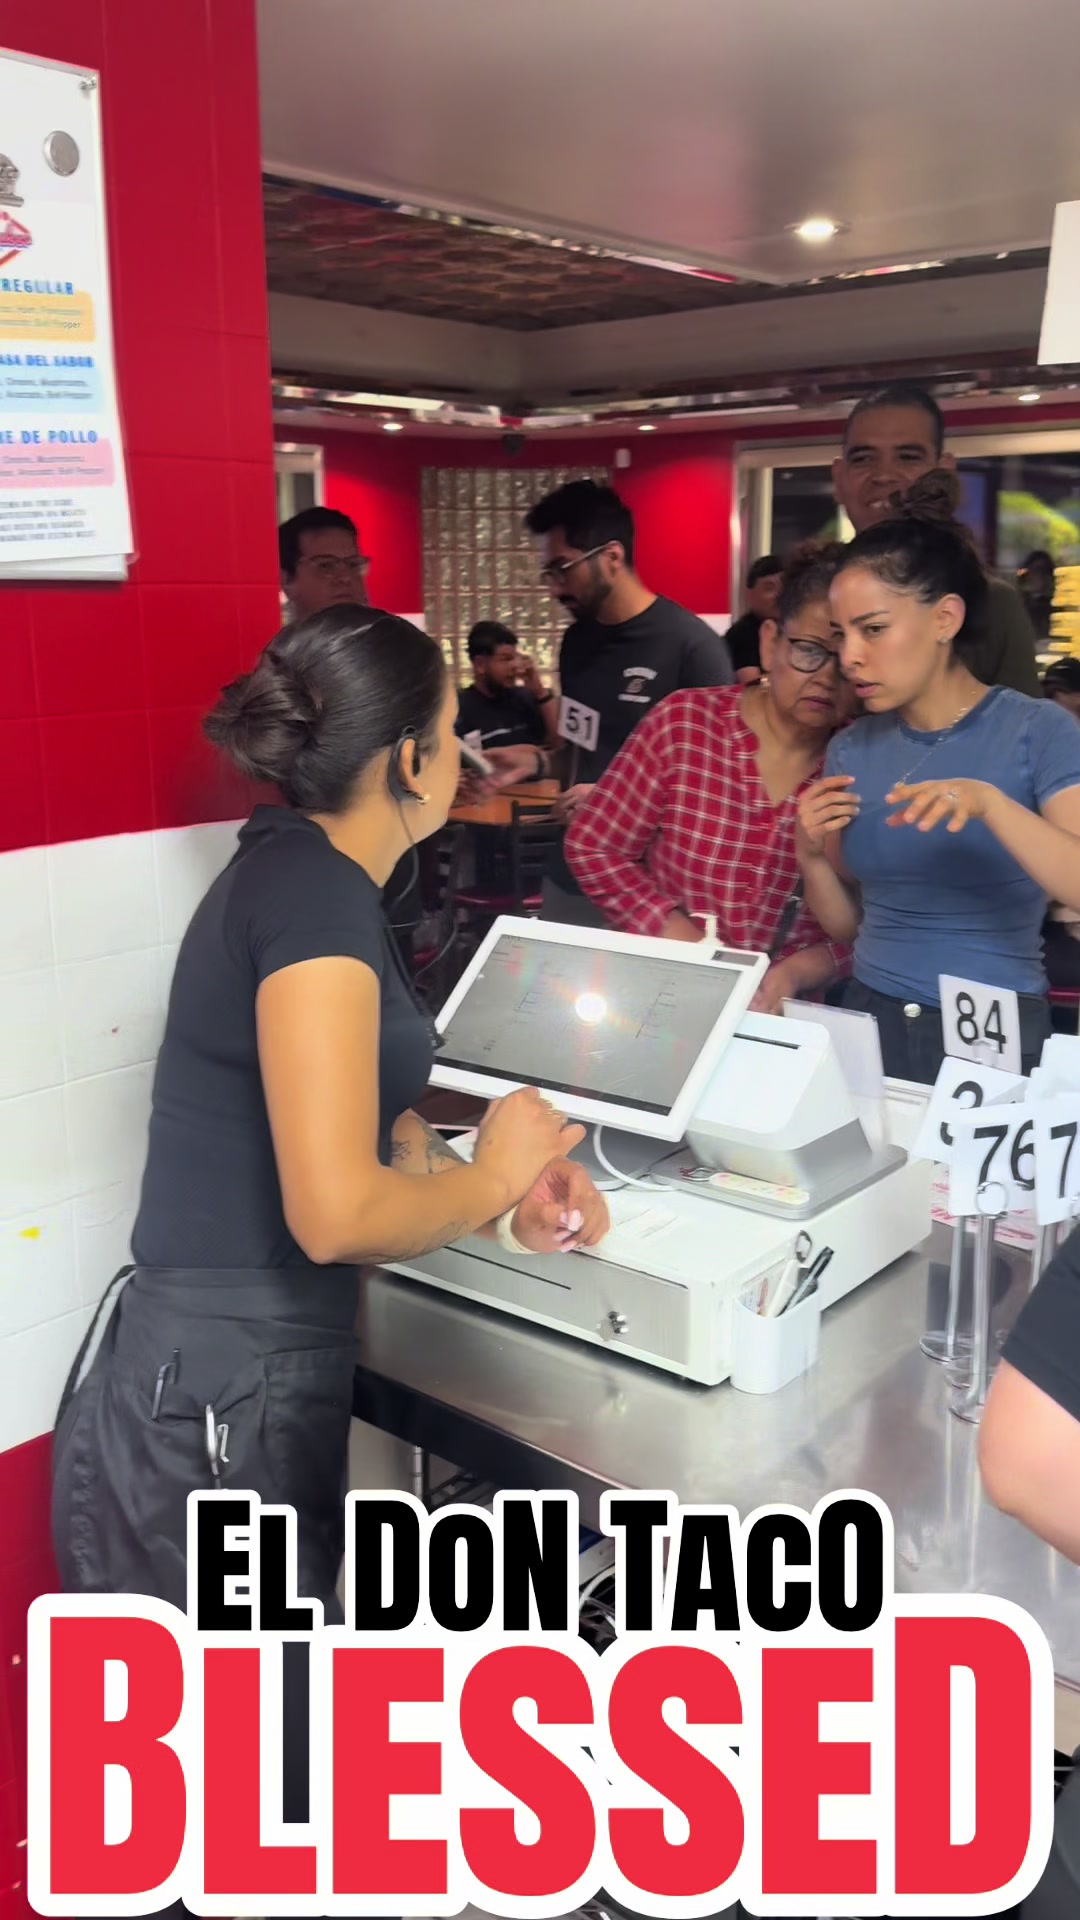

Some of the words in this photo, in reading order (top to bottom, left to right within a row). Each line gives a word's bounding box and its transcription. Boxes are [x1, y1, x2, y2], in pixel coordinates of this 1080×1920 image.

[2, 278, 73, 295] REGULAR
[21, 430, 41, 444] DE
[47, 430, 97, 444] POLLO
[566, 706, 593, 741] 51
[955, 991, 1007, 1054] 84
[973, 1119, 1035, 1192] 76
